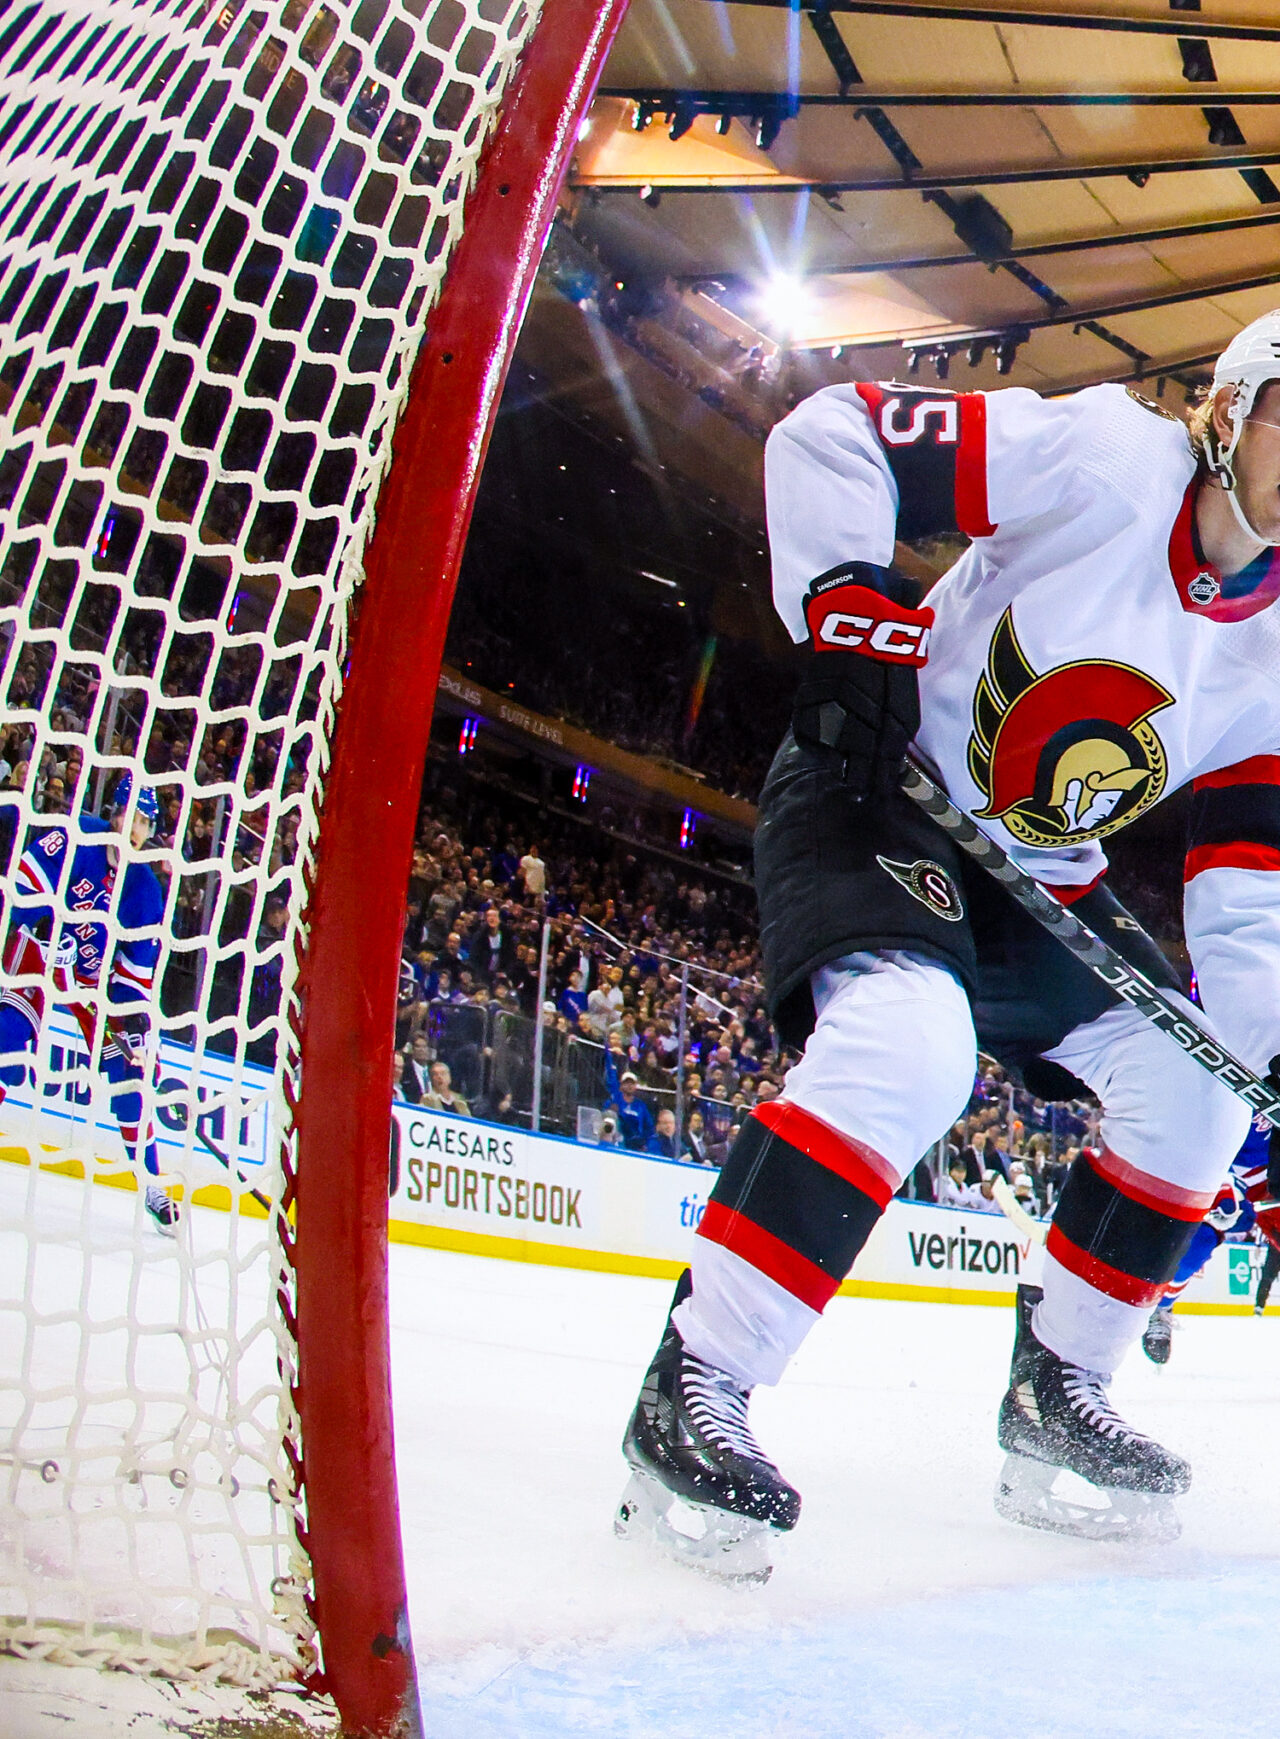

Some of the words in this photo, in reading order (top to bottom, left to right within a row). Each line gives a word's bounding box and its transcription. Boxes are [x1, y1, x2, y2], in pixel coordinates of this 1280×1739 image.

[877, 382, 959, 447] 5
[816, 574, 853, 593] SANDERSON
[409, 1121, 514, 1166] CAESARS
[407, 1158, 582, 1228] SPORTSBOOK
[908, 1226, 1020, 1275] verizon
